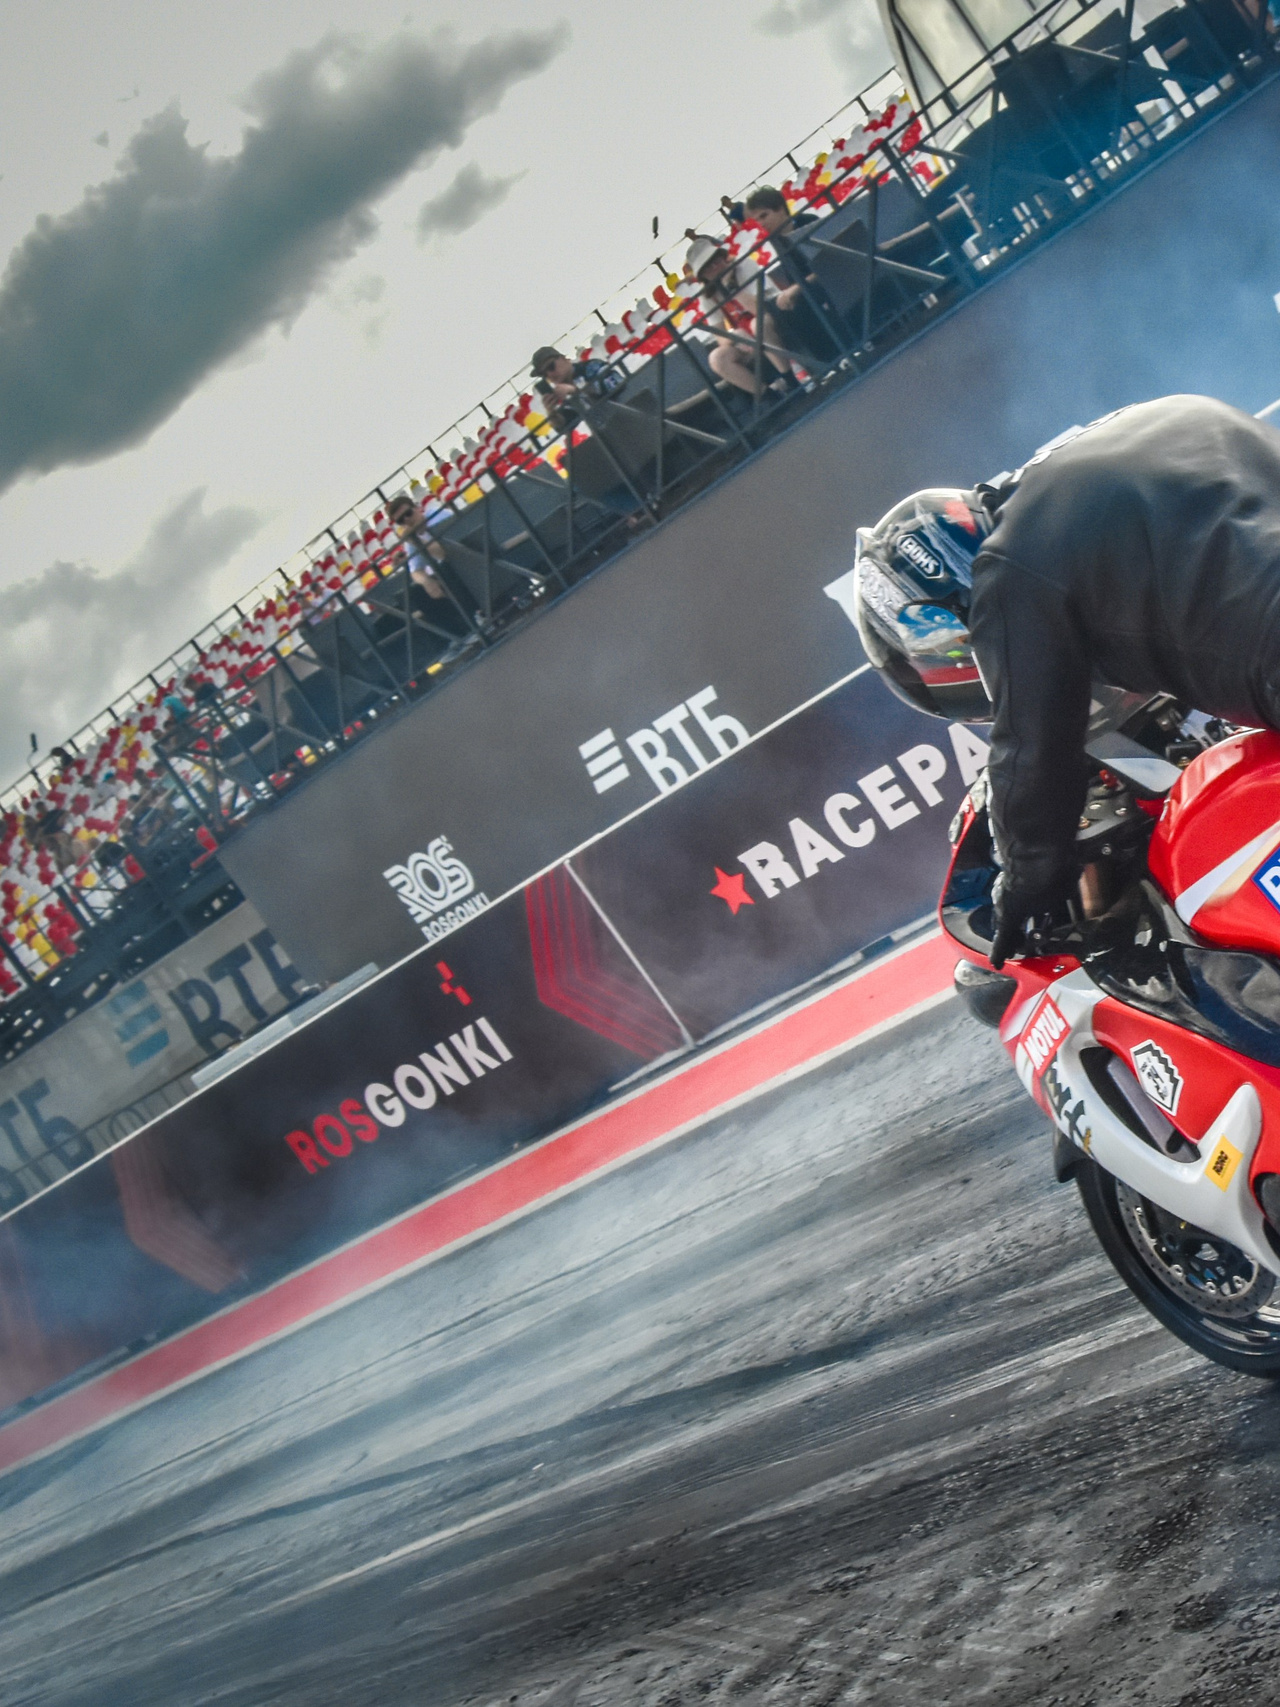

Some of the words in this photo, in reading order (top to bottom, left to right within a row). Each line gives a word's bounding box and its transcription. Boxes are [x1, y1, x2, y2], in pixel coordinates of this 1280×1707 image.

[901, 537, 939, 574] SHOEI
[420, 891, 493, 941] ROSGONKI
[1024, 1003, 1066, 1070] MOTUL
[284, 1016, 514, 1174] ROSGONKI
